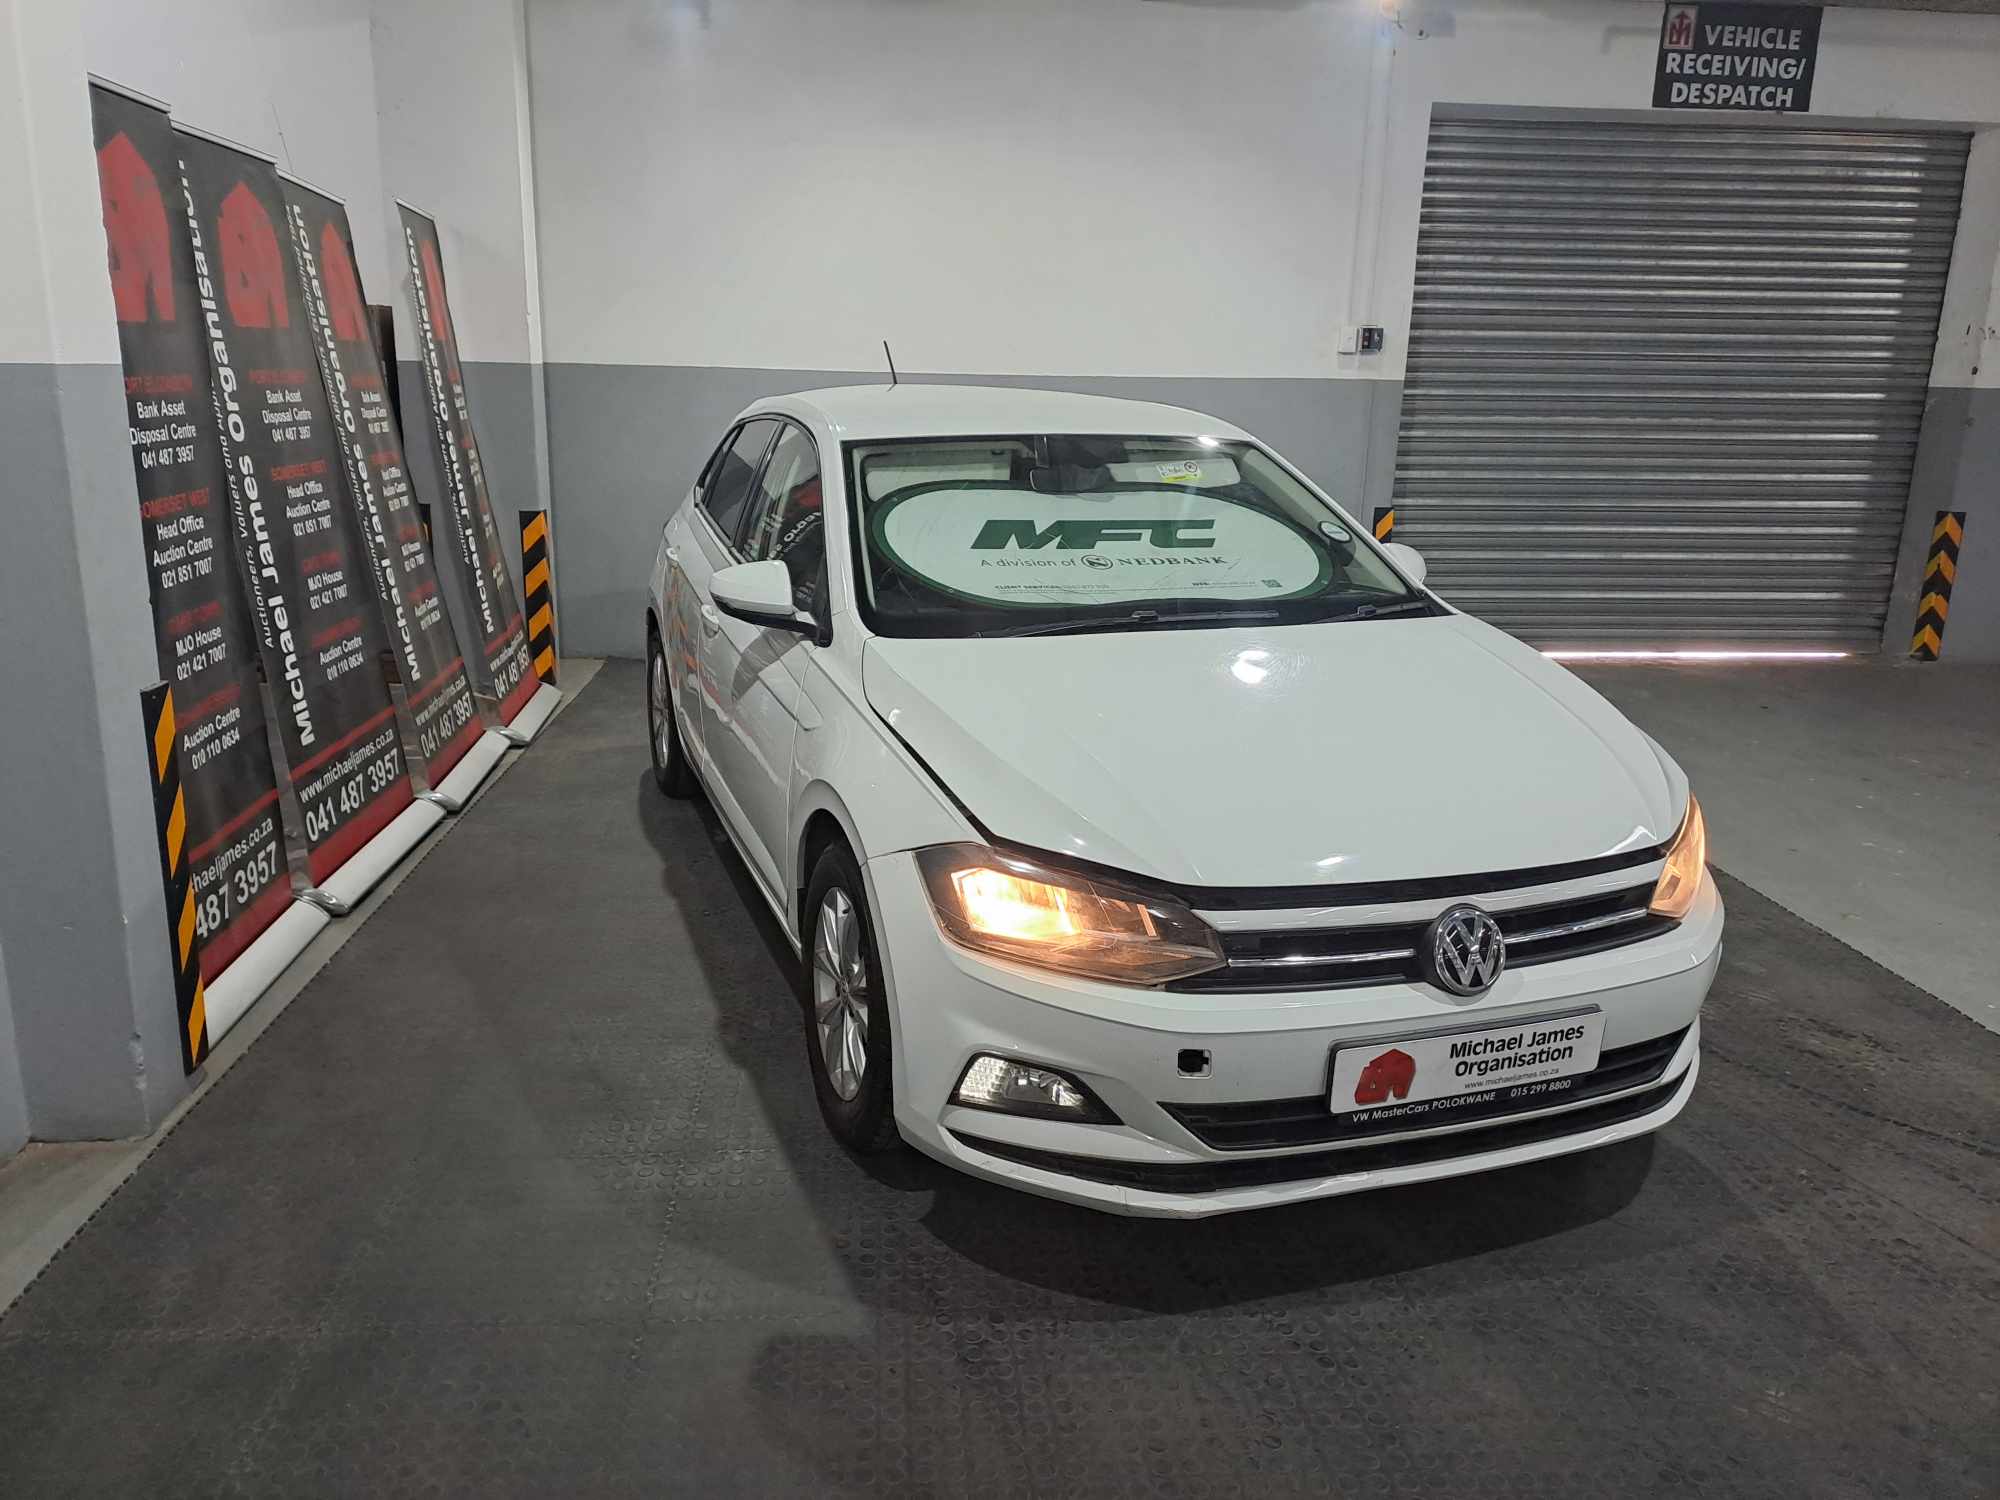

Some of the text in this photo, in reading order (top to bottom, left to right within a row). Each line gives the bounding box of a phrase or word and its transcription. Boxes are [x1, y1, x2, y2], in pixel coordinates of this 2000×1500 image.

[1704, 25, 1801, 50] VEHICLE
[1666, 53, 1806, 80] RECEIVING/
[1671, 82, 1793, 108] DESPATCH
[292, 204, 356, 433] Organisation
[406, 227, 449, 422] Organisation
[136, 400, 186, 418] Bank Asset
[266, 389, 302, 403] Bank Asset
[262, 408, 312, 425] Disposal Centre
[130, 424, 196, 446] Disposal Centre
[271, 428, 284, 442] 041
[141, 445, 194, 469] 041 487 3957
[178, 159, 316, 747] Michael James Organisati
[286, 481, 323, 499] Head Office
[445, 430, 470, 520] James
[286, 499, 331, 518] Auction Centre
[353, 443, 387, 549] James
[156, 516, 205, 541] Head Office
[219, 434, 275, 649] Auctioneers, Valuers and
[293, 522, 305, 536] 021
[970, 519, 1216, 550] MFC
[153, 536, 213, 567] Auction Centre
[980, 556, 1228, 568] A division of NEDBANK
[162, 557, 213, 589] 021 851 7007
[322, 571, 343, 586] House
[465, 527, 495, 634] Michael
[309, 595, 321, 610] 021
[381, 558, 421, 682] Michael
[175, 626, 222, 657] MJO House
[320, 635, 363, 665] Auction Centre
[177, 643, 226, 681] 021 421 7007
[183, 706, 241, 752] Auction Centre
[420, 691, 473, 758] 041 487 3957
[191, 728, 240, 770] 010 110 0634
[300, 729, 394, 803] www.michaeljames.co.za
[306, 748, 399, 842] 041 487 3957
[192, 817, 273, 892] haeljames.co.za
[195, 841, 277, 939] 487 3957
[1450, 1025, 1585, 1059] Michael James
[1455, 1045, 1574, 1077] Organisation
[1352, 1079, 1571, 1123] VW MasterCars POLOKWANE 015 299 8800
